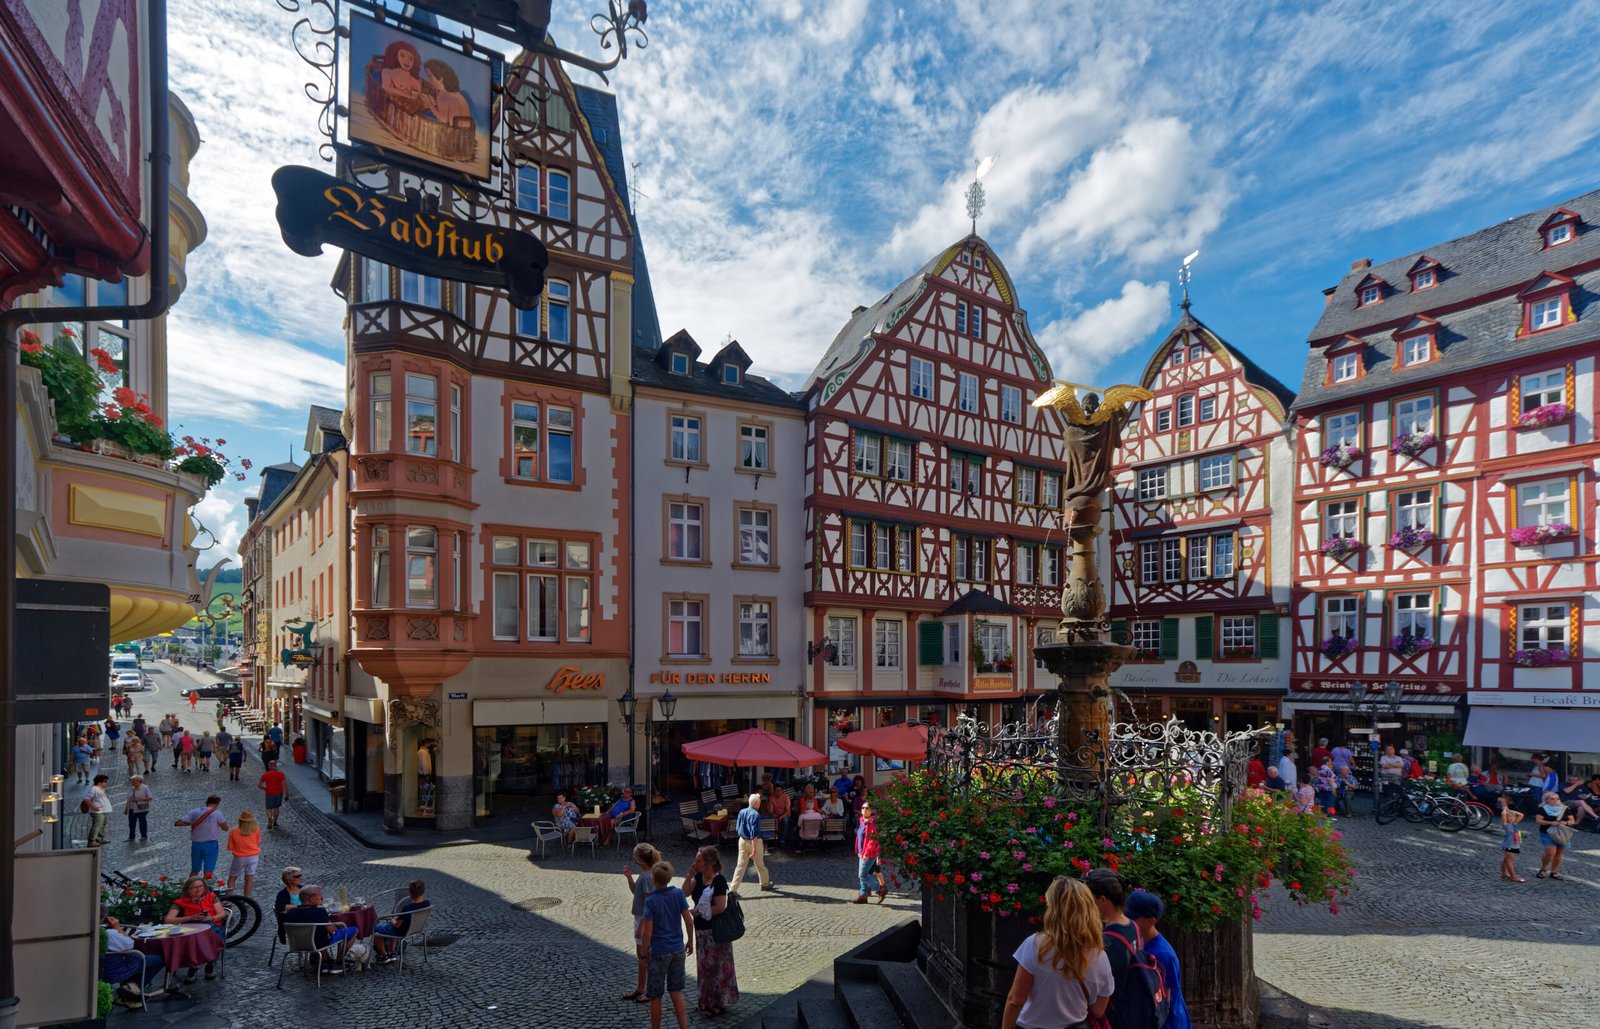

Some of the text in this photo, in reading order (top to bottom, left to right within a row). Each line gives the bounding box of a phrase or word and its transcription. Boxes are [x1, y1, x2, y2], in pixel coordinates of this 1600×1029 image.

[546, 665, 605, 693] Hees
[649, 671, 771, 684] FÜR DEN HERRN
[937, 677, 961, 689] Apotheke
[1217, 672, 1236, 683] Die
[1533, 694, 1578, 705] Eiscafé
